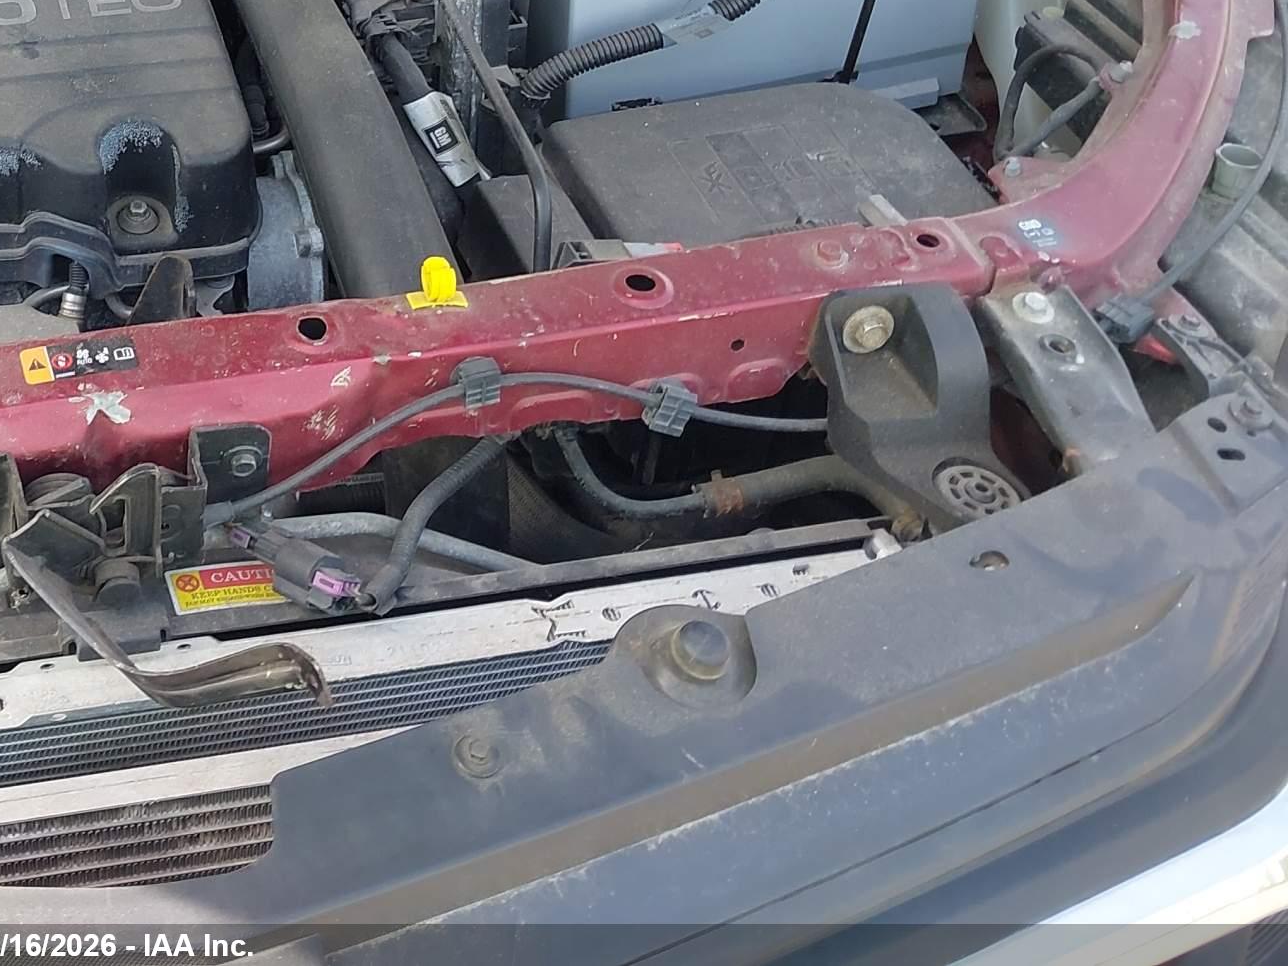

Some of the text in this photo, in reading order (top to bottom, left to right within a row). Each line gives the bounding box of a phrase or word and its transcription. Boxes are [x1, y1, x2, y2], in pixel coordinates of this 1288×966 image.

[434, 126, 452, 146] GM
[191, 590, 220, 600] KEEP
[224, 586, 261, 596] HANDS
